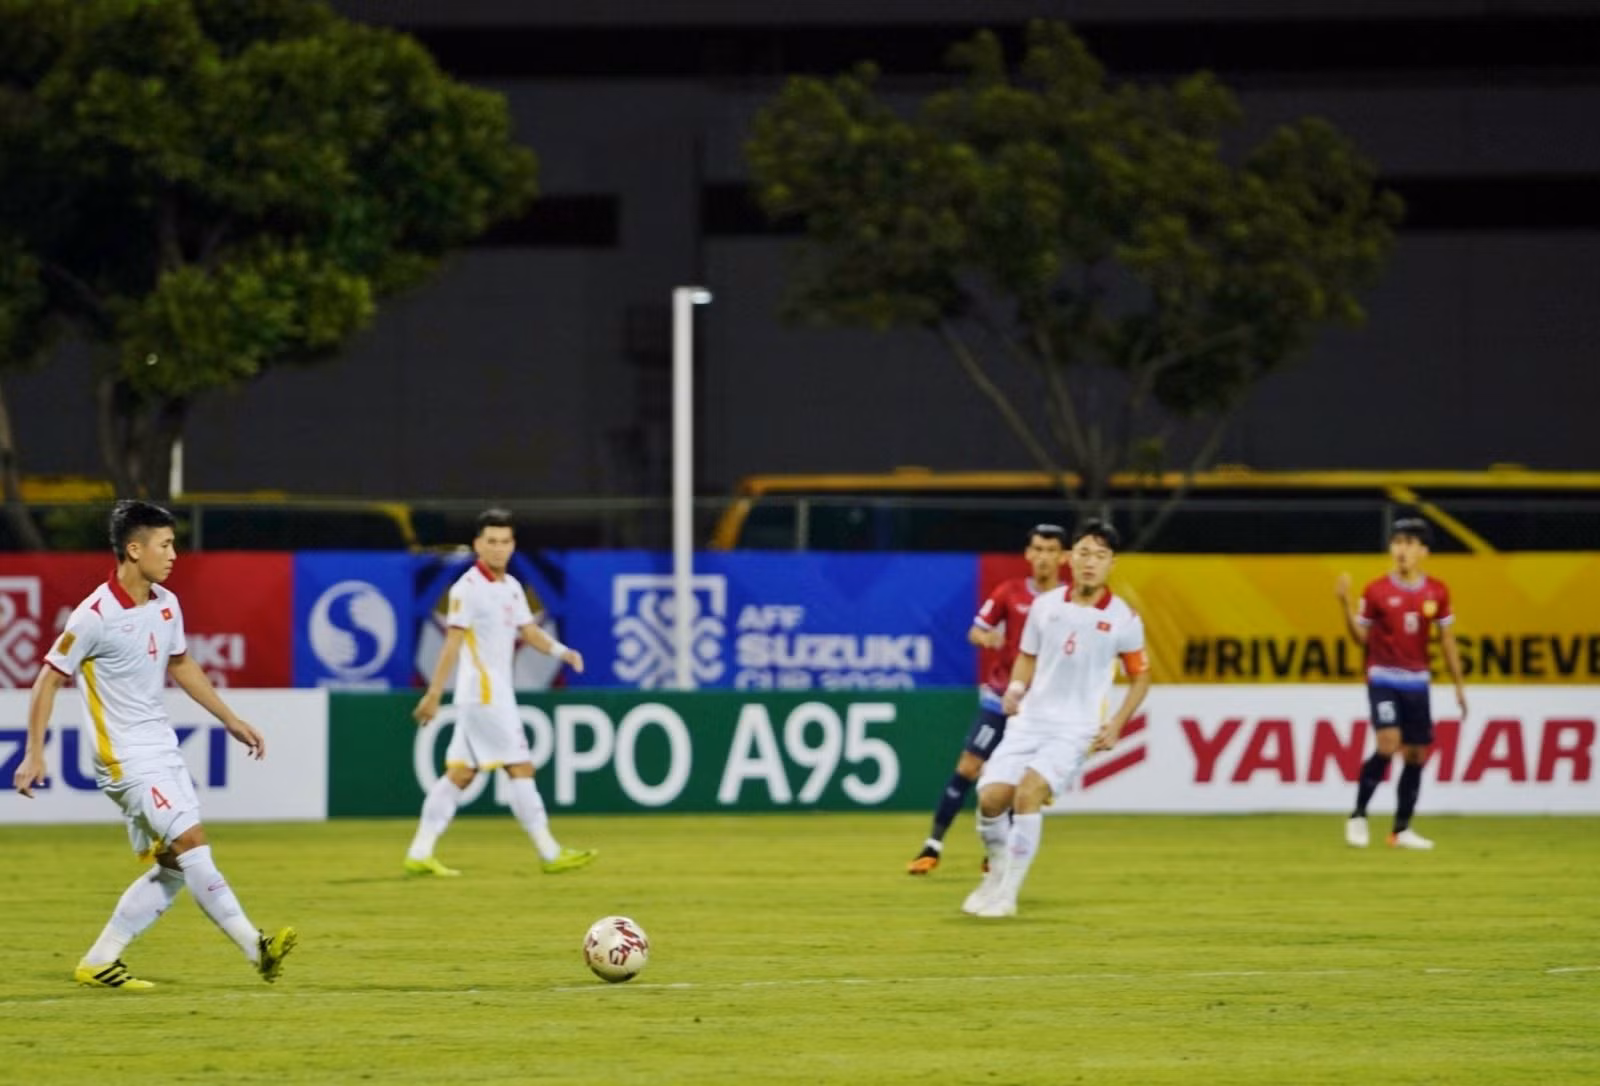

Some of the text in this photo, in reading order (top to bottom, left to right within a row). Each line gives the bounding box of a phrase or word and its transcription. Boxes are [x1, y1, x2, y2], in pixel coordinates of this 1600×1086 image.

[737, 604, 806, 631] AFF
[147, 631, 158, 662] 4
[736, 632, 932, 672] SUZUKI
[1063, 631, 1077, 656] 6
[717, 701, 901, 805] A95
[151, 786, 172, 811] 4
